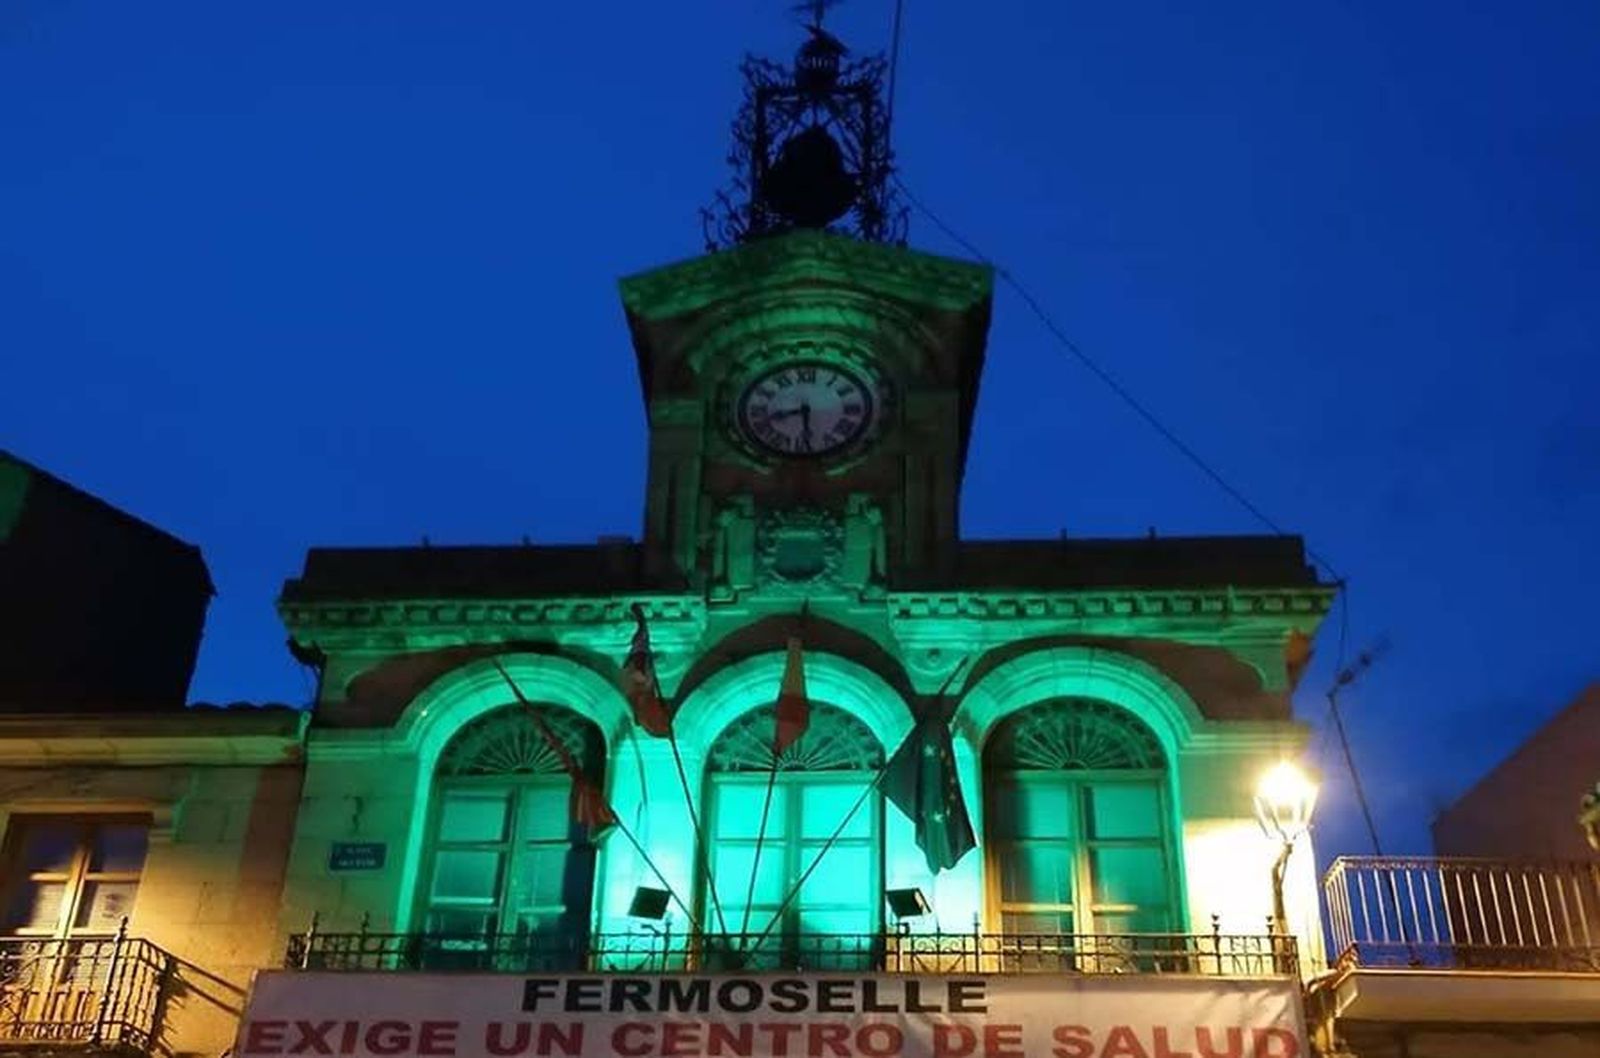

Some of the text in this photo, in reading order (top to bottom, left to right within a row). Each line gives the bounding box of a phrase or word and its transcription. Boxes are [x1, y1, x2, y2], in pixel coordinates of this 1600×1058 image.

[521, 979, 989, 1014] FERMOSELLE
[244, 1021, 1300, 1058] EXIGE UN CENTRO DE SALUD
